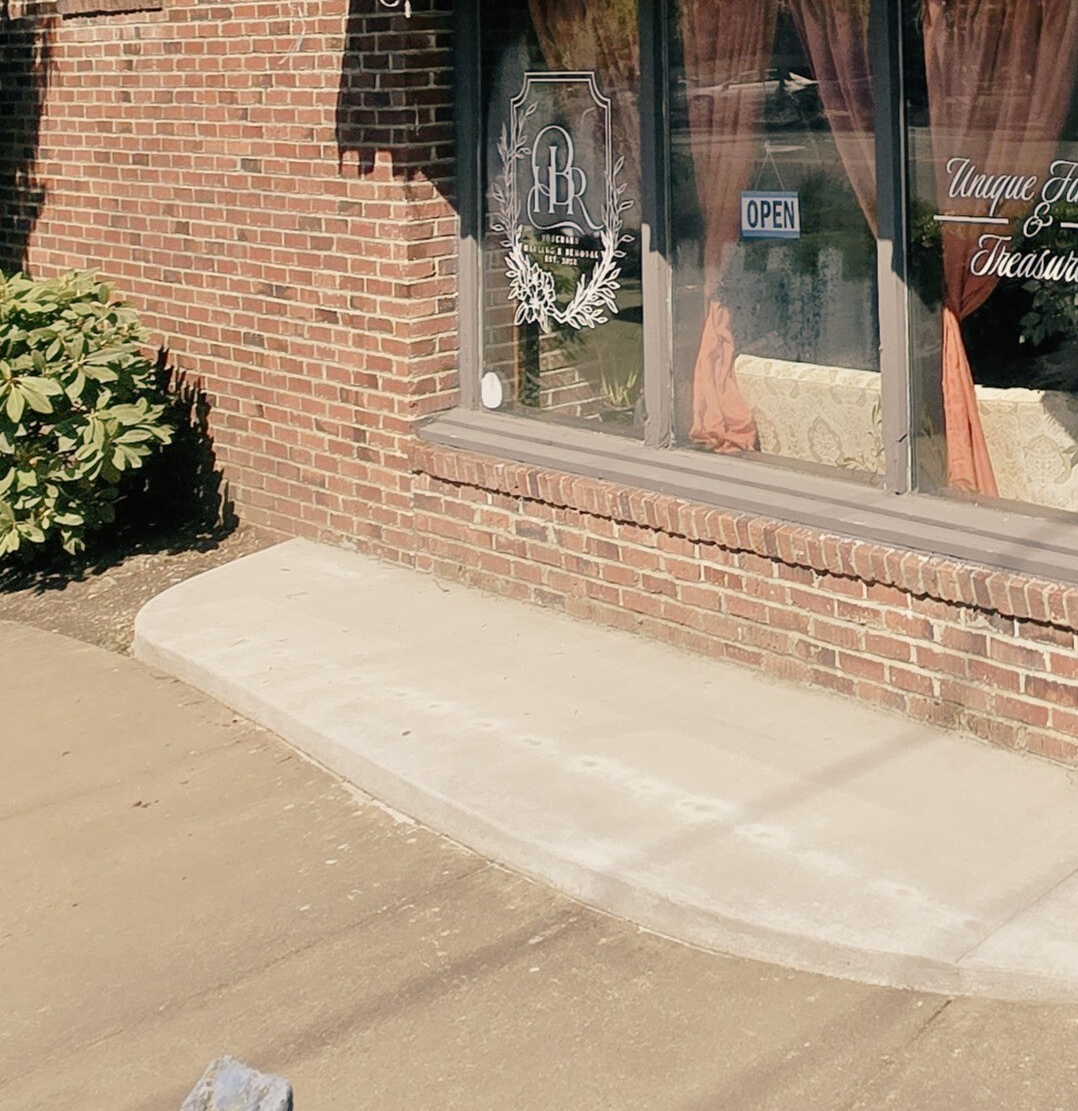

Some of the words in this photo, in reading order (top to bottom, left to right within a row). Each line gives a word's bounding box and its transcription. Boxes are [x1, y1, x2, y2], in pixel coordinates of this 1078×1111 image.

[946, 157, 1038, 217] Unique
[746, 199, 795, 230] OPEN
[1023, 201, 1053, 238] &
